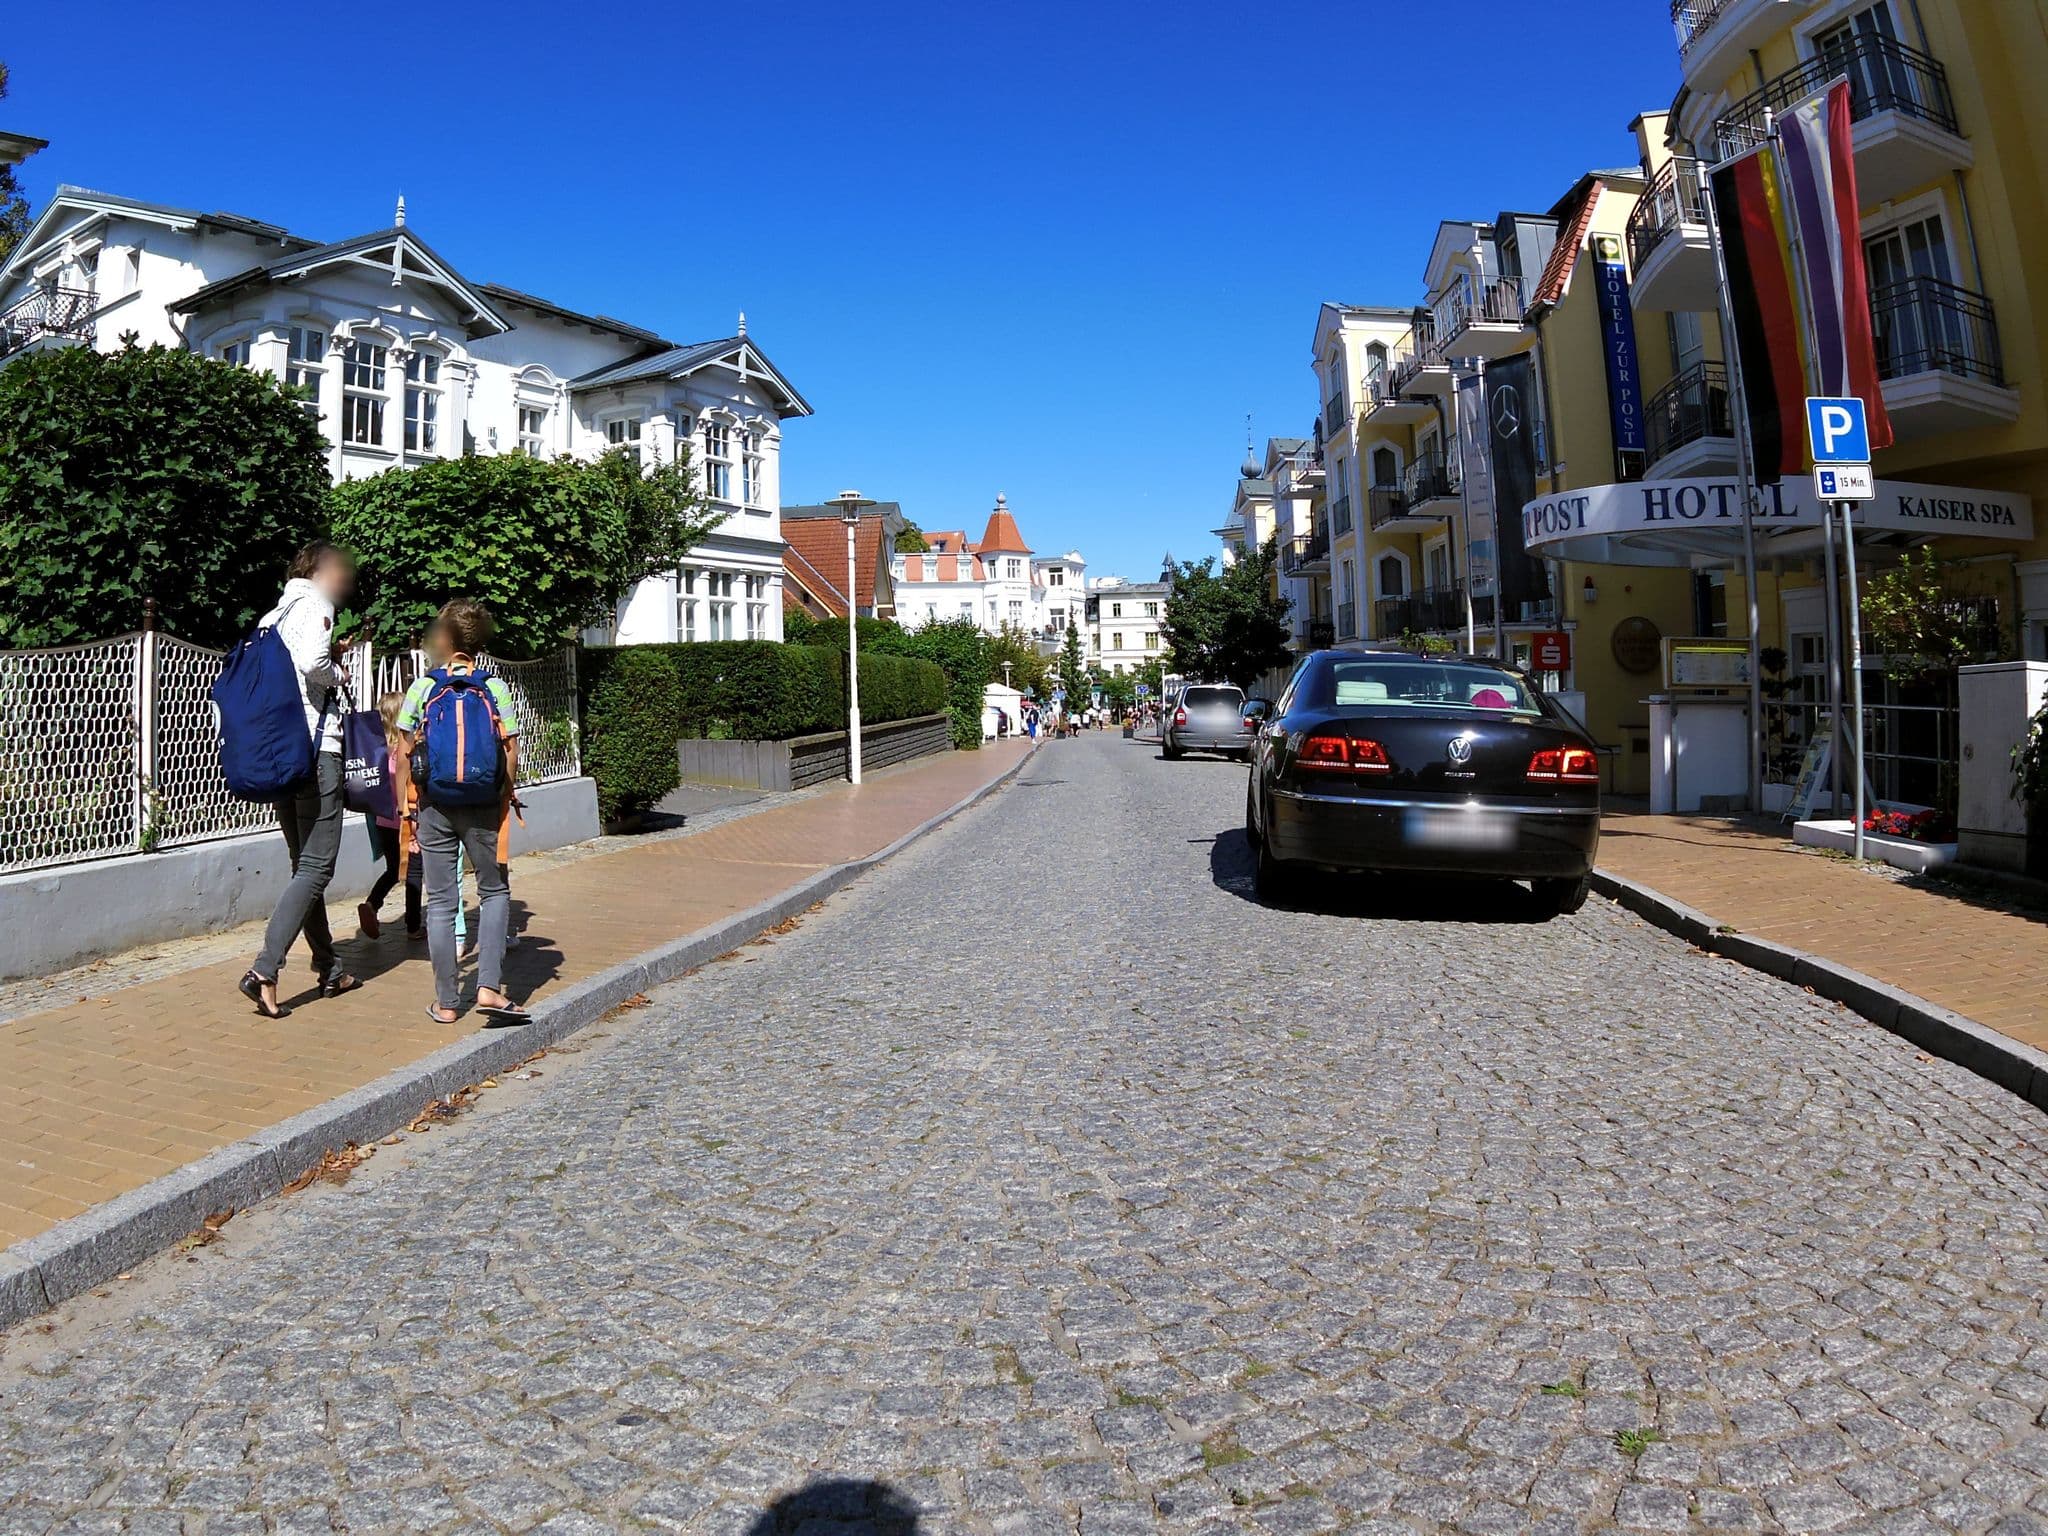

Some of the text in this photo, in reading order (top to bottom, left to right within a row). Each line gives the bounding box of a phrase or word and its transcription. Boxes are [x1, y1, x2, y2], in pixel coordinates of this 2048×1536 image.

[1606, 266, 1635, 444] HOTEL ZUR POST
[1821, 406, 1853, 454] P
[1840, 477, 1867, 488] 15 Min.
[1534, 496, 1589, 537] POST
[1898, 496, 2016, 526] KAISER SPA
